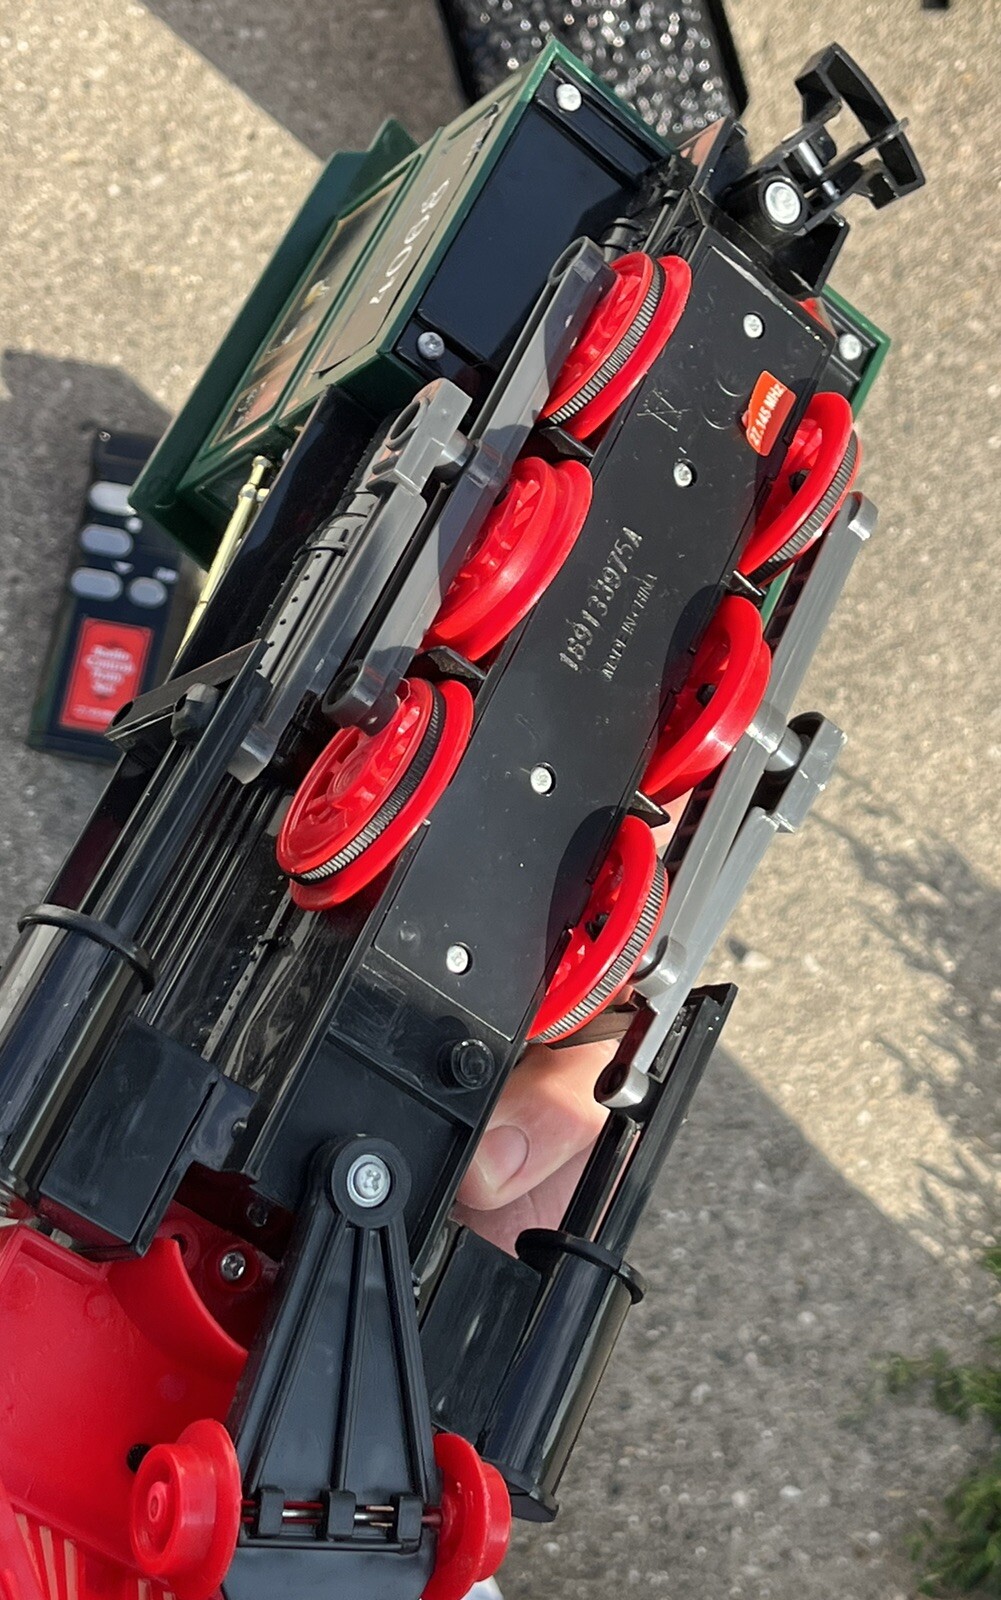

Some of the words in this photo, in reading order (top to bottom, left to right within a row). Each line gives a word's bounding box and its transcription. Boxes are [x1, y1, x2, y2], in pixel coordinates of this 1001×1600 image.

[749, 406, 772, 447] 27.145
[763, 383, 787, 410] MHz
[621, 616, 638, 635] IN
